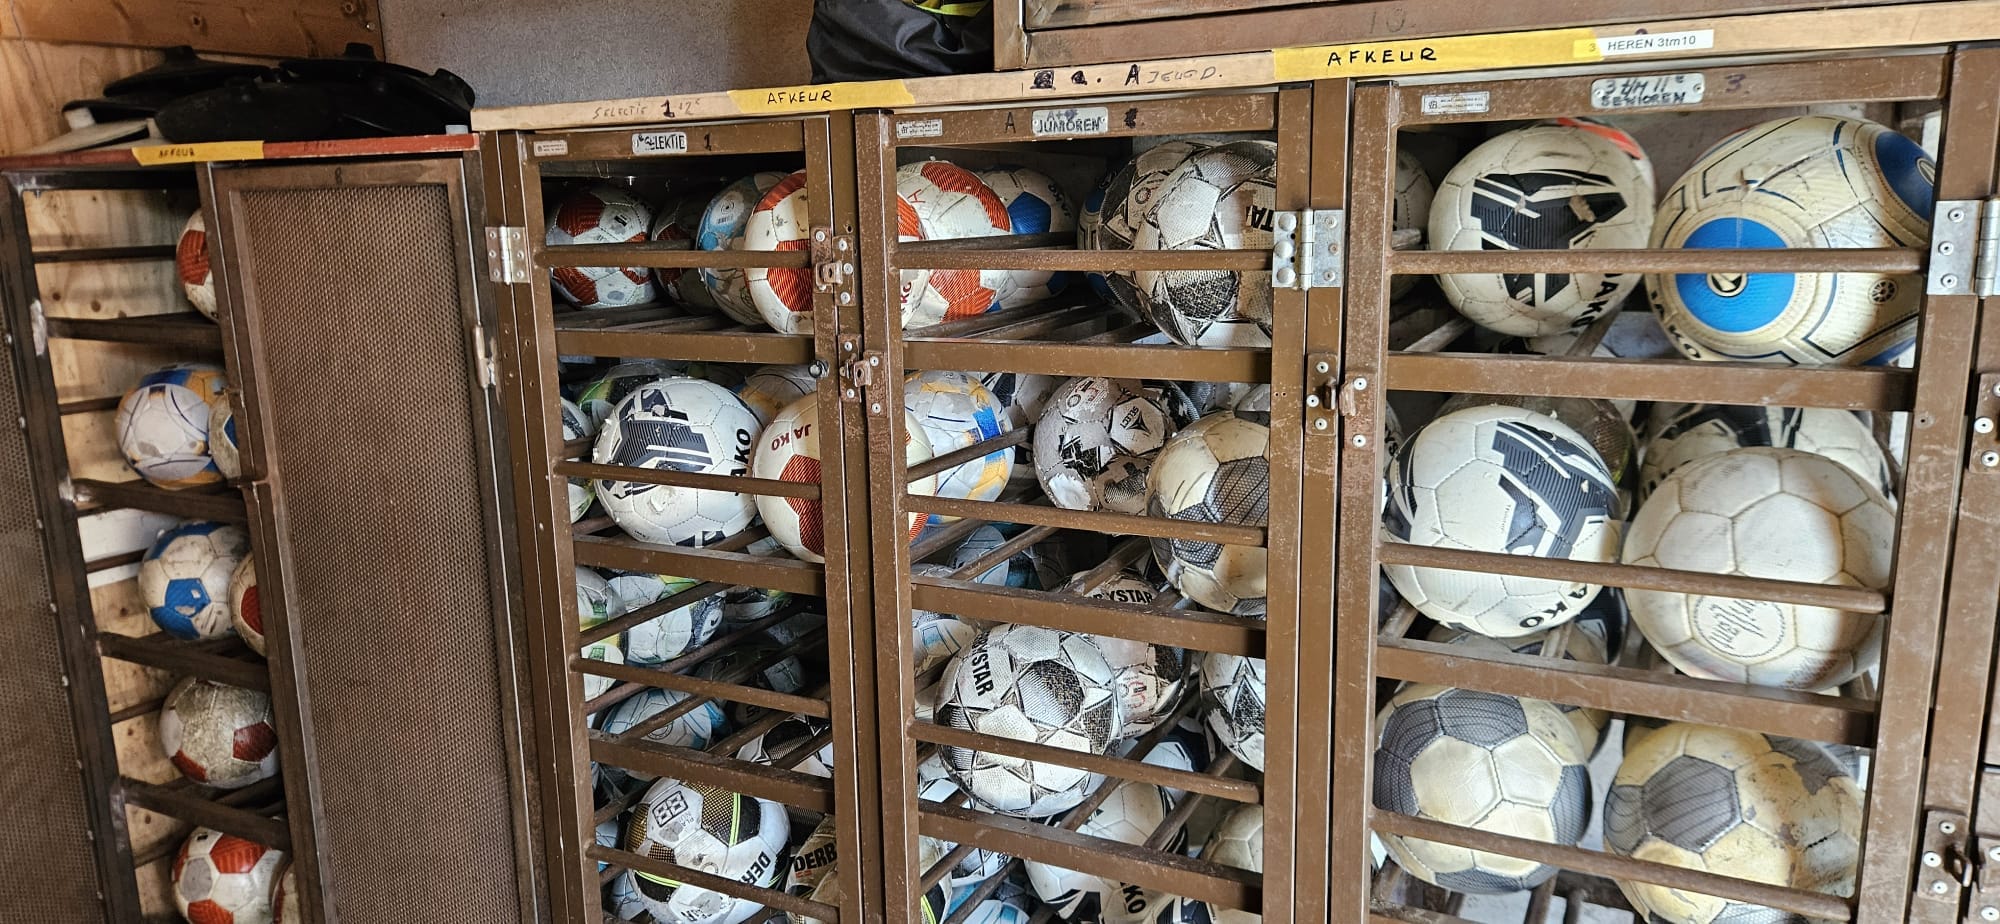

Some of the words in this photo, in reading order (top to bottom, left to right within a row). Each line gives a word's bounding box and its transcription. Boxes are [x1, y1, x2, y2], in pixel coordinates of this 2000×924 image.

[1608, 38, 1653, 51] HEREN
[1657, 35, 1696, 47] 3tm10
[1327, 47, 1437, 66] AFKEUR
[767, 90, 832, 105] AFKEUR
[772, 423, 812, 451] JAKO
[1519, 583, 1588, 628] AKO
